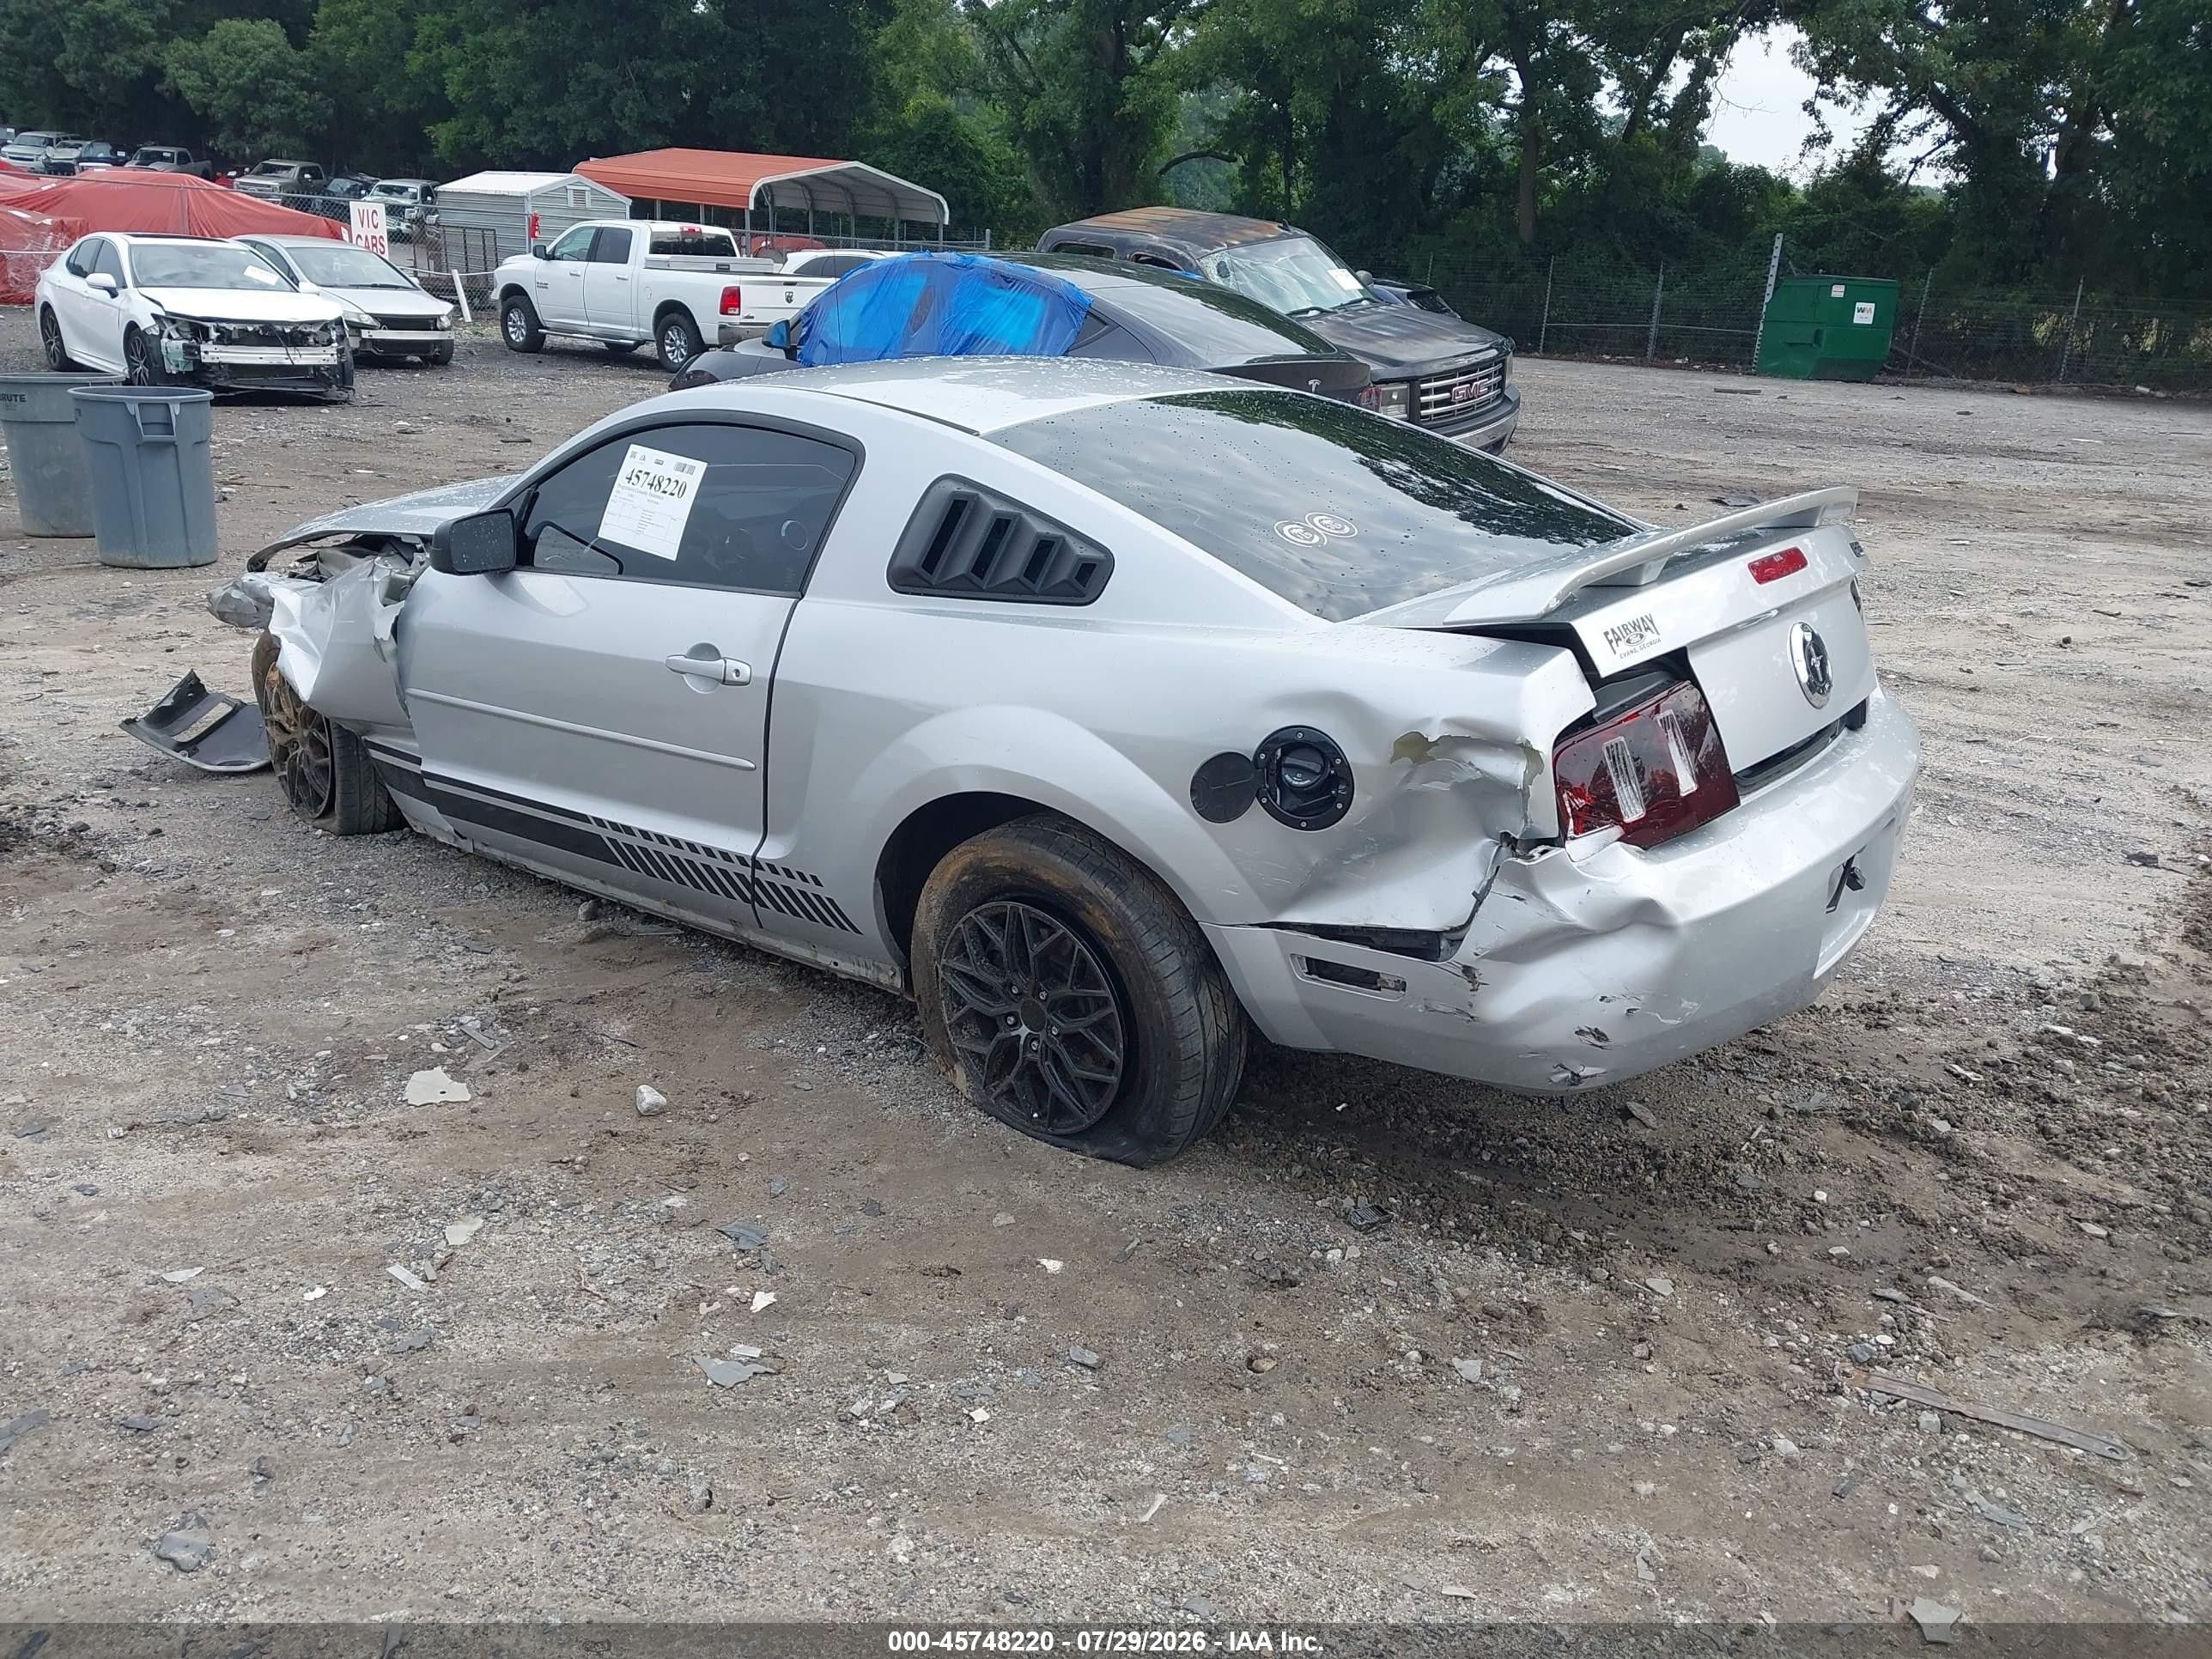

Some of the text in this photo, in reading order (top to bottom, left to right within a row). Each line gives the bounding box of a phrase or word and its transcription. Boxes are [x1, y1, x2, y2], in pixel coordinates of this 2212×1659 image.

[357, 208, 379, 230] VIC
[356, 234, 386, 255] CARS
[1856, 306, 1873, 315] WM
[0, 393, 27, 403] RUTE
[1451, 378, 1489, 403] GMC
[625, 467, 688, 499] 45748220
[1602, 612, 1661, 656] FAIRWAY
[1638, 637, 1662, 651] GEORGIA
